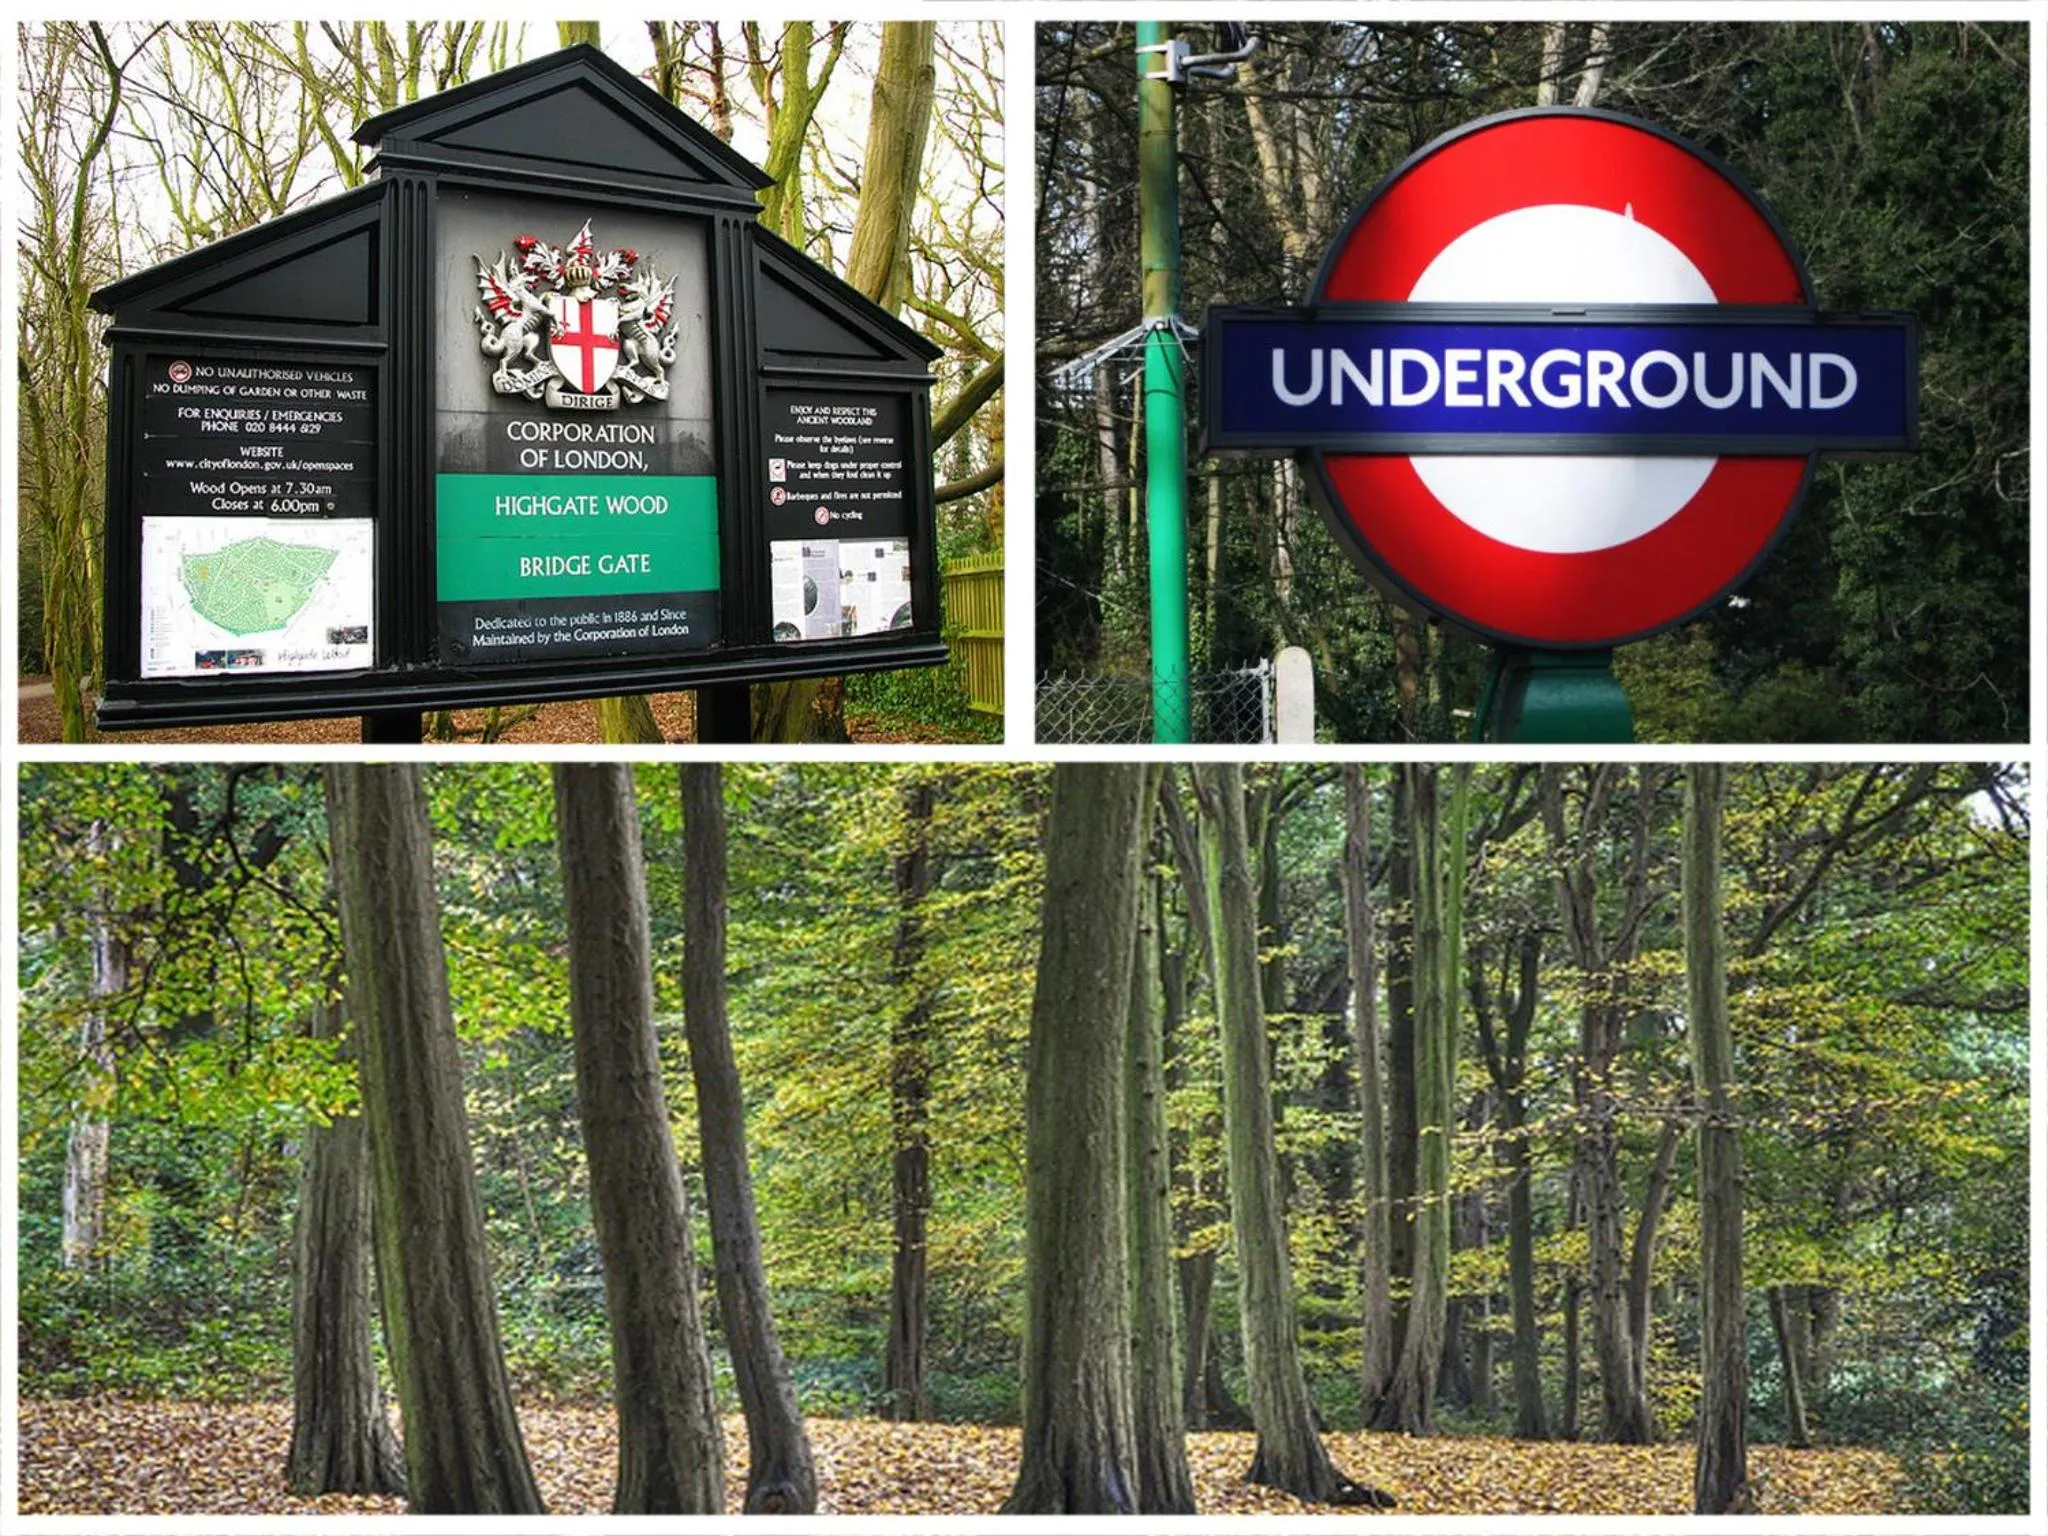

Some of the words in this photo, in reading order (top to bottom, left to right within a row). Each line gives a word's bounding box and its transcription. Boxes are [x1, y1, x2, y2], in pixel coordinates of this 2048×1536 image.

[196, 366, 214, 377] NO
[218, 367, 302, 381] UNAUTHORISED
[306, 371, 354, 383] VEHICLES
[1272, 348, 1858, 410] UNDERGROUND
[153, 384, 170, 393] NO
[173, 384, 220, 395] DUMPING
[223, 385, 236, 396] OF
[239, 386, 280, 397] GARDEN
[284, 388, 297, 398] OR
[300, 388, 332, 399] OTHER
[337, 390, 367, 400] WASTE
[561, 394, 614, 409] DIRIGE
[178, 407, 200, 419] FOR
[204, 408, 261, 421] ENQUIRIES
[272, 410, 343, 423] EMERGENCIES
[201, 421, 238, 432] PHONE
[245, 422, 265, 433] 020
[269, 422, 296, 434] 8444
[507, 421, 655, 444] CORPORATION
[240, 446, 284, 458] WEBSITE
[165, 458, 354, 471] www.cityoflondon.gov.uk/openspaces
[520, 449, 548, 468] OF
[554, 450, 649, 472] LONDON,
[190, 482, 226, 494] Wood
[229, 482, 267, 496] Opens
[270, 484, 281, 494] at
[286, 482, 332, 494] 7.30am
[212, 498, 249, 510] Closes
[252, 499, 264, 510] at
[270, 499, 320, 513] 6.00pm
[496, 496, 599, 516] HIGHGATE
[606, 496, 669, 515] WOOD
[520, 556, 591, 577] BRIDGE
[598, 554, 651, 574] GATE
[475, 617, 532, 631] Dedicated
[535, 618, 547, 628] to
[550, 616, 567, 626] the
[570, 613, 600, 627] public
[602, 613, 612, 623] in
[615, 611, 638, 623] 1886
[640, 610, 658, 621] and
[660, 608, 687, 621] Since
[472, 634, 535, 647] Maintained
[537, 632, 550, 645] by
[554, 631, 571, 642] the
[574, 626, 636, 641] Corporation
[638, 625, 650, 636] of
[652, 624, 689, 637] London
